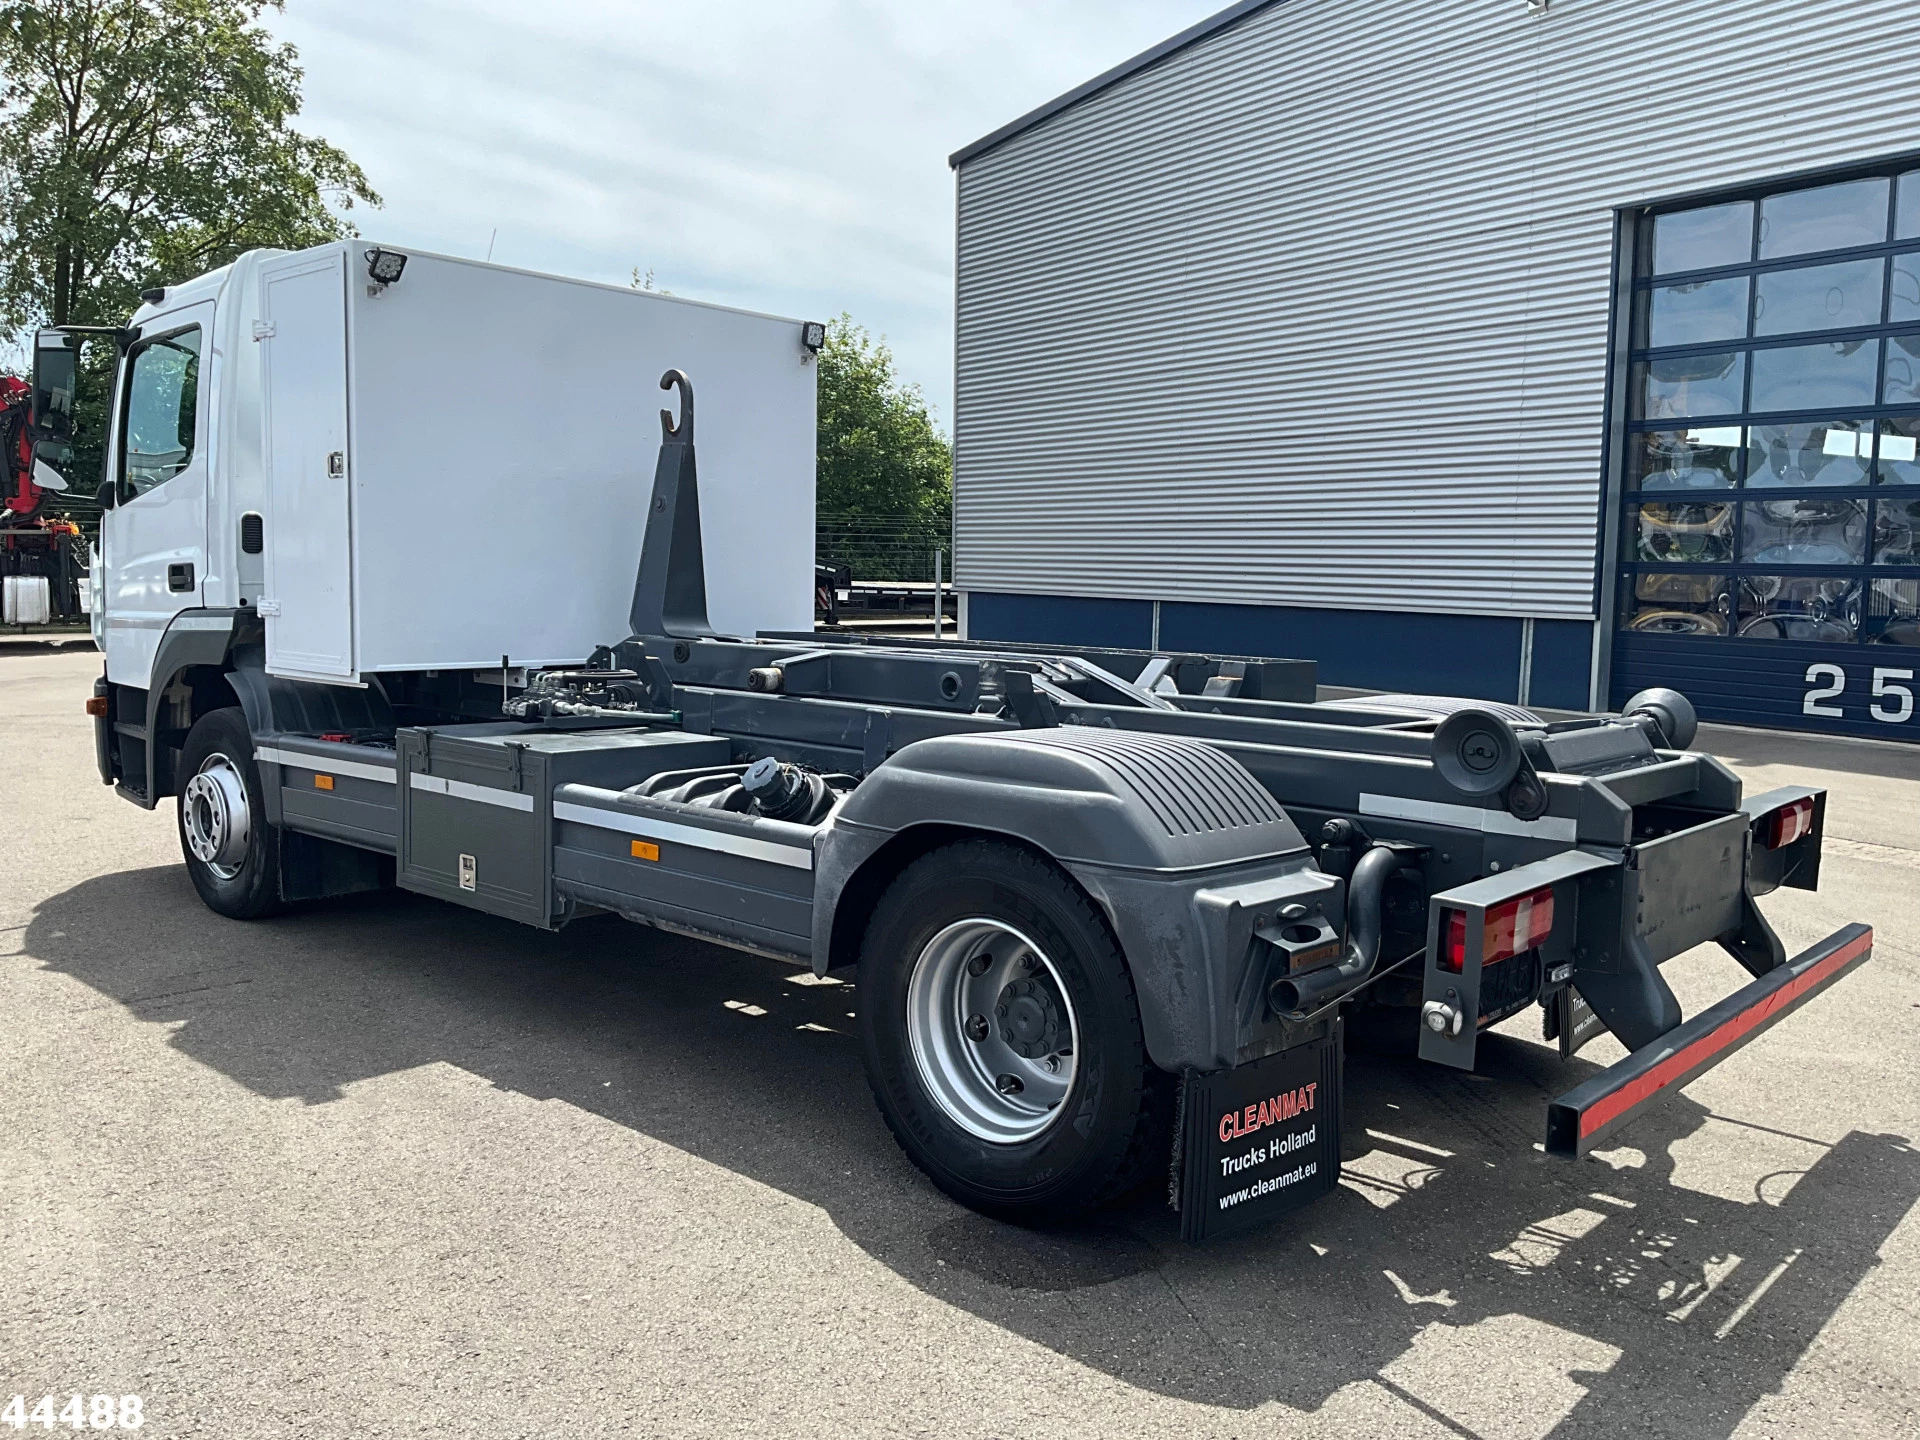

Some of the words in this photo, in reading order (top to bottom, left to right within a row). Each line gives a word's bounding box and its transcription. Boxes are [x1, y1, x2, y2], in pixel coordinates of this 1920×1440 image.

[1802, 663, 1914, 723] 25
[1219, 1082, 1317, 1143] CLEANMAT
[1220, 1147, 1266, 1177] Trucks
[1269, 1124, 1316, 1160] Holland
[1219, 1161, 1317, 1210] www.cleanmat.eu
